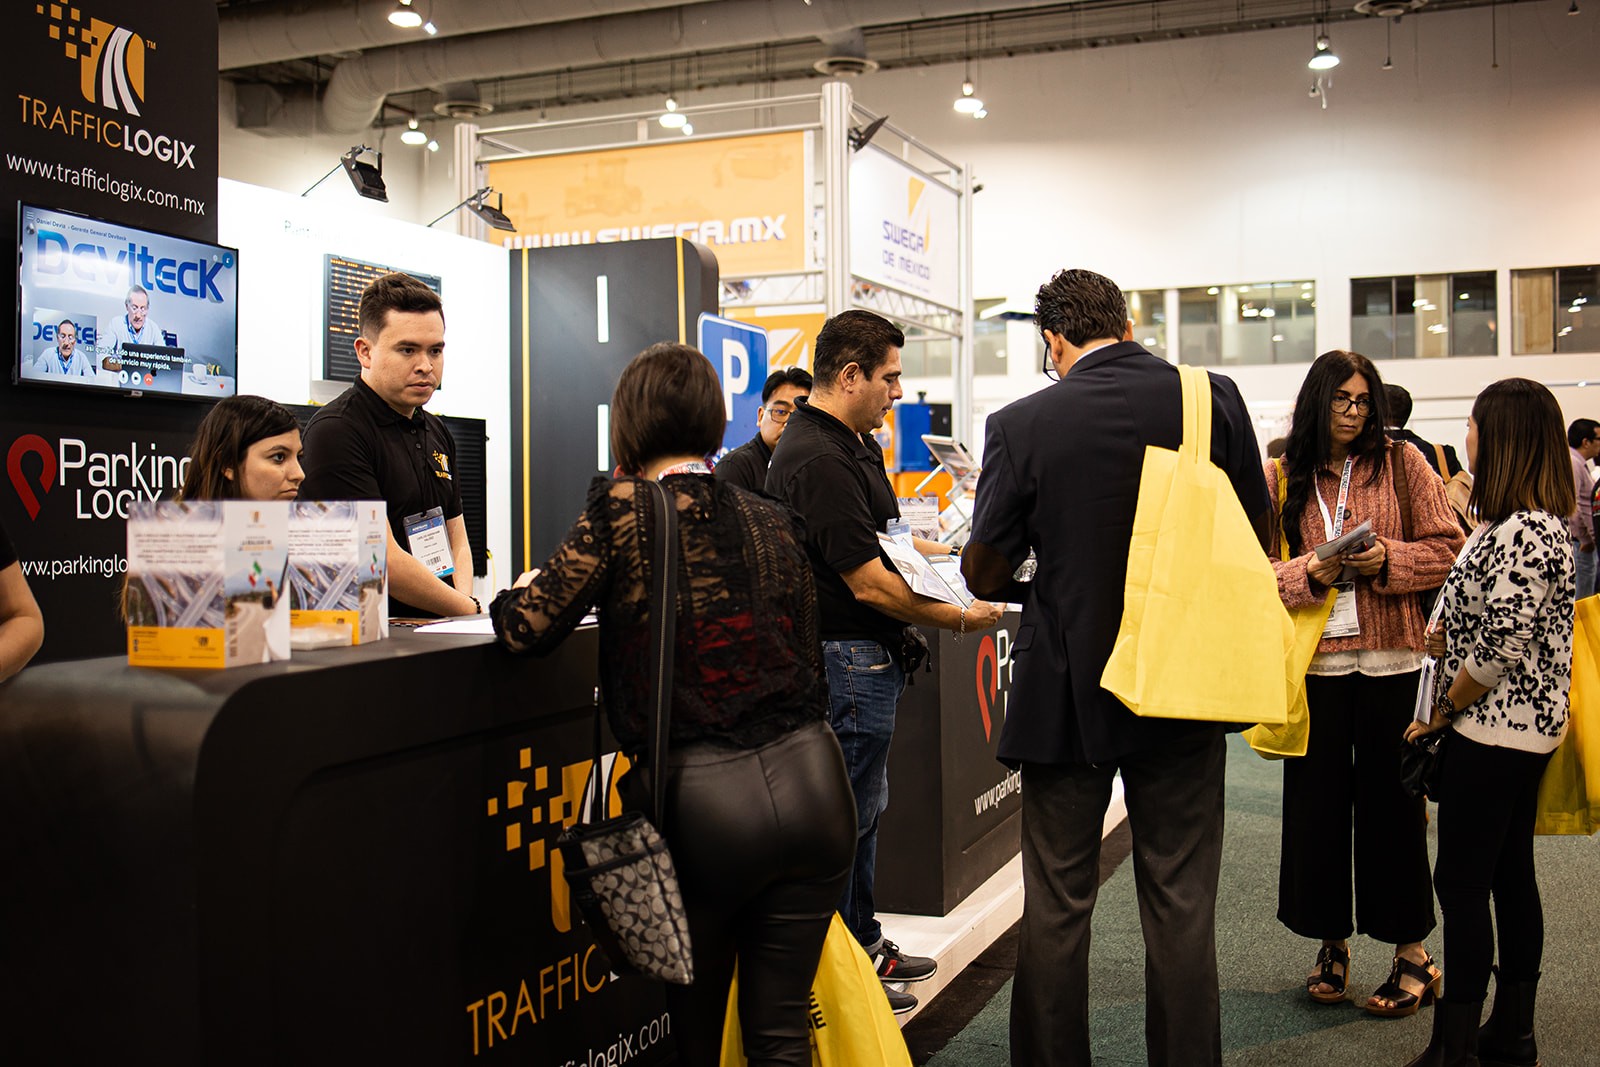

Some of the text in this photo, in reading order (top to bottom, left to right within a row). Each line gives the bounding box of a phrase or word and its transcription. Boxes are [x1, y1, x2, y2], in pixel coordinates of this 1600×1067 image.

[18, 94, 196, 169] TRAFFICLOGIX
[6, 153, 205, 215] www.trafficlogix.com.mx
[722, 338, 750, 421] P
[975, 763, 1022, 816] www.parking
[466, 943, 606, 1056] TRAFFIC
